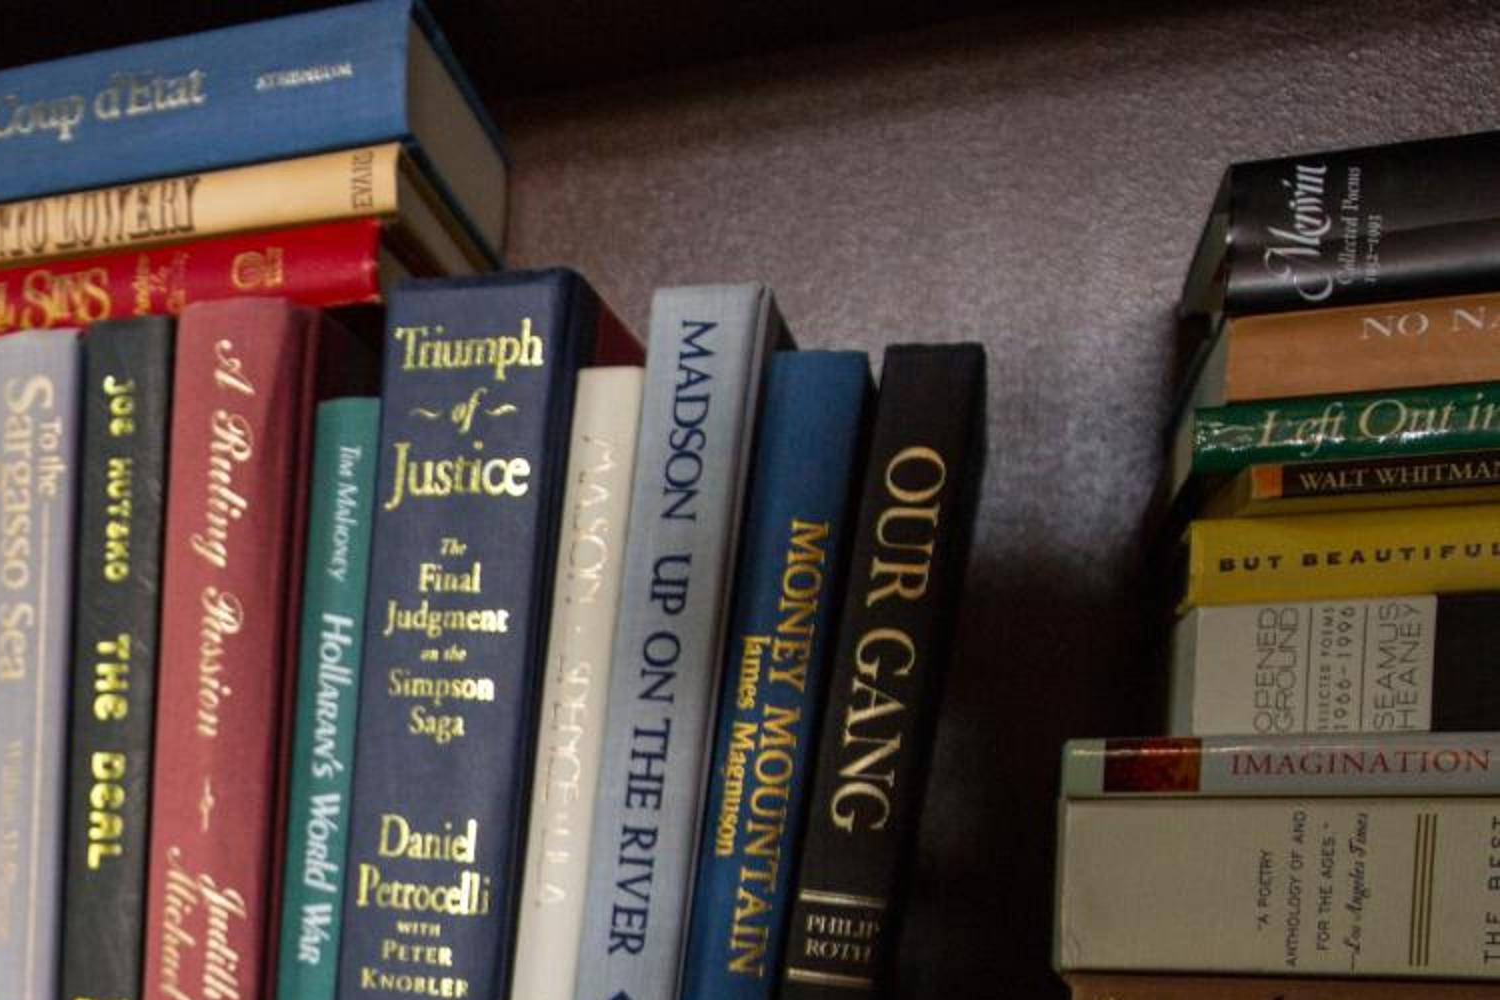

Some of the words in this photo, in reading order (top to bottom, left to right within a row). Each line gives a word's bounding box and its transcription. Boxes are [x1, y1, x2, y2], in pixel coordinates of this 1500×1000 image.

[394, 318, 544, 381] Triumph
[1361, 312, 1429, 341] NO
[213, 339, 256, 396] A
[450, 387, 488, 433] of
[660, 318, 719, 522] MADSON
[1256, 401, 1346, 456] Left
[1359, 399, 1456, 441] Out
[0, 375, 55, 589] Sargasso
[189, 409, 255, 569] Ruling
[383, 441, 531, 509] Justice
[1300, 469, 1373, 492] WALT
[439, 537, 468, 556] The
[867, 446, 948, 607] OUR
[418, 562, 481, 593] Final
[649, 553, 692, 616] UP
[1220, 555, 1284, 572] BUT
[384, 600, 510, 638] Judgment
[768, 519, 830, 692] MONEY
[93, 633, 131, 720] THE
[196, 584, 246, 738] Passion
[421, 647, 439, 662] on
[443, 643, 468, 662] the
[638, 631, 682, 703] ON
[737, 634, 772, 710] James
[1252, 607, 1279, 733] OPENED
[1273, 607, 1300, 734] GROUND
[1373, 602, 1401, 729] SEAMUS
[1395, 603, 1422, 730] HEANEY
[388, 668, 495, 706] Simpson
[409, 705, 465, 744] Saga
[830, 627, 916, 833] GANG
[626, 717, 672, 812] THE
[1231, 749, 1490, 776] IMAGINATION
[88, 751, 127, 870] DEAL
[378, 813, 478, 864] Daniel
[1293, 810, 1308, 843] AND
[728, 703, 800, 979] MOUNTAIN
[1289, 848, 1304, 872] OF
[356, 862, 490, 916] Petrocelli
[608, 824, 659, 957] RIVER
[1319, 879, 1333, 913] THE
[396, 920, 441, 937] WITH
[806, 914, 880, 939] PHILIP
[1285, 876, 1303, 967] ANTHOLOGY
[1316, 919, 1330, 952] FOR
[381, 938, 453, 967] PETER
[360, 967, 469, 999] KNOBLER
